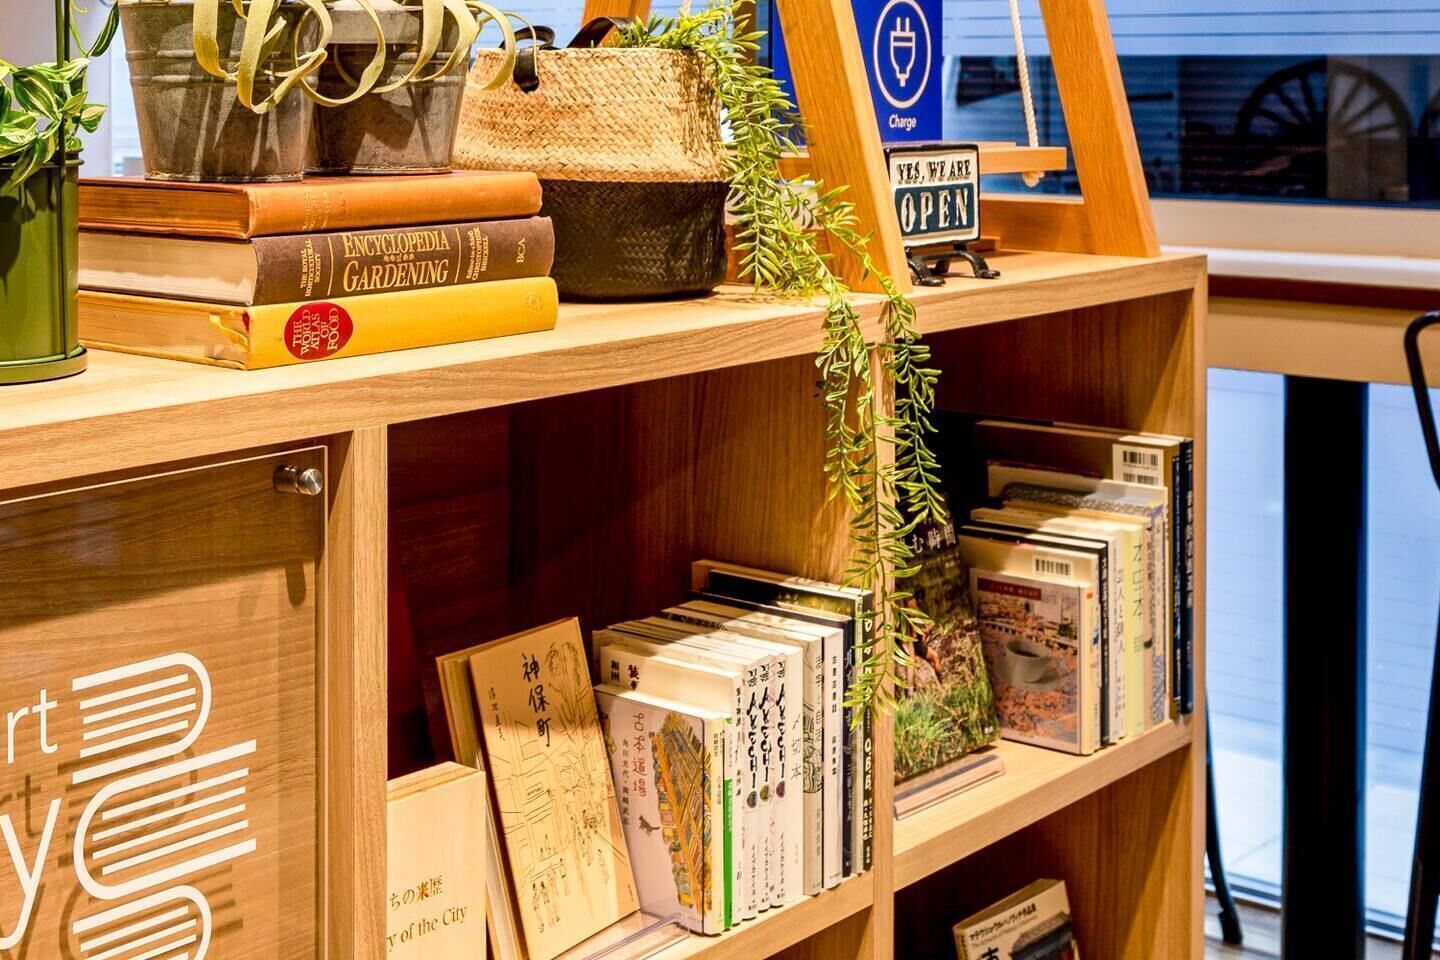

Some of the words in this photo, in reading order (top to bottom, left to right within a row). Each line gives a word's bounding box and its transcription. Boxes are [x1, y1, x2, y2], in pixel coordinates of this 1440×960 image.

[889, 114, 916, 131] Charge
[896, 161, 925, 184] YES,
[927, 160, 946, 180] WE
[948, 158, 972, 179] ARE
[901, 188, 968, 232] OPEN
[342, 229, 451, 258] ENCYCLOPEDIA
[515, 237, 526, 263] BCA
[300, 248, 308, 273] ROYAL
[314, 252, 322, 283] SOCIETY
[343, 258, 449, 292] GARDENING
[300, 273, 308, 289] THE
[292, 320, 302, 348] THE
[300, 309, 312, 356] WORLD
[310, 312, 321, 350] ATLAS
[320, 320, 330, 338] OF
[326, 307, 340, 351] FOOD
[521, 652, 551, 747] 神保町
[632, 711, 648, 799] 古本道場
[389, 874, 444, 913] ちの来歴
[400, 922, 415, 943] of
[418, 917, 439, 937] the
[442, 906, 469, 927] City
